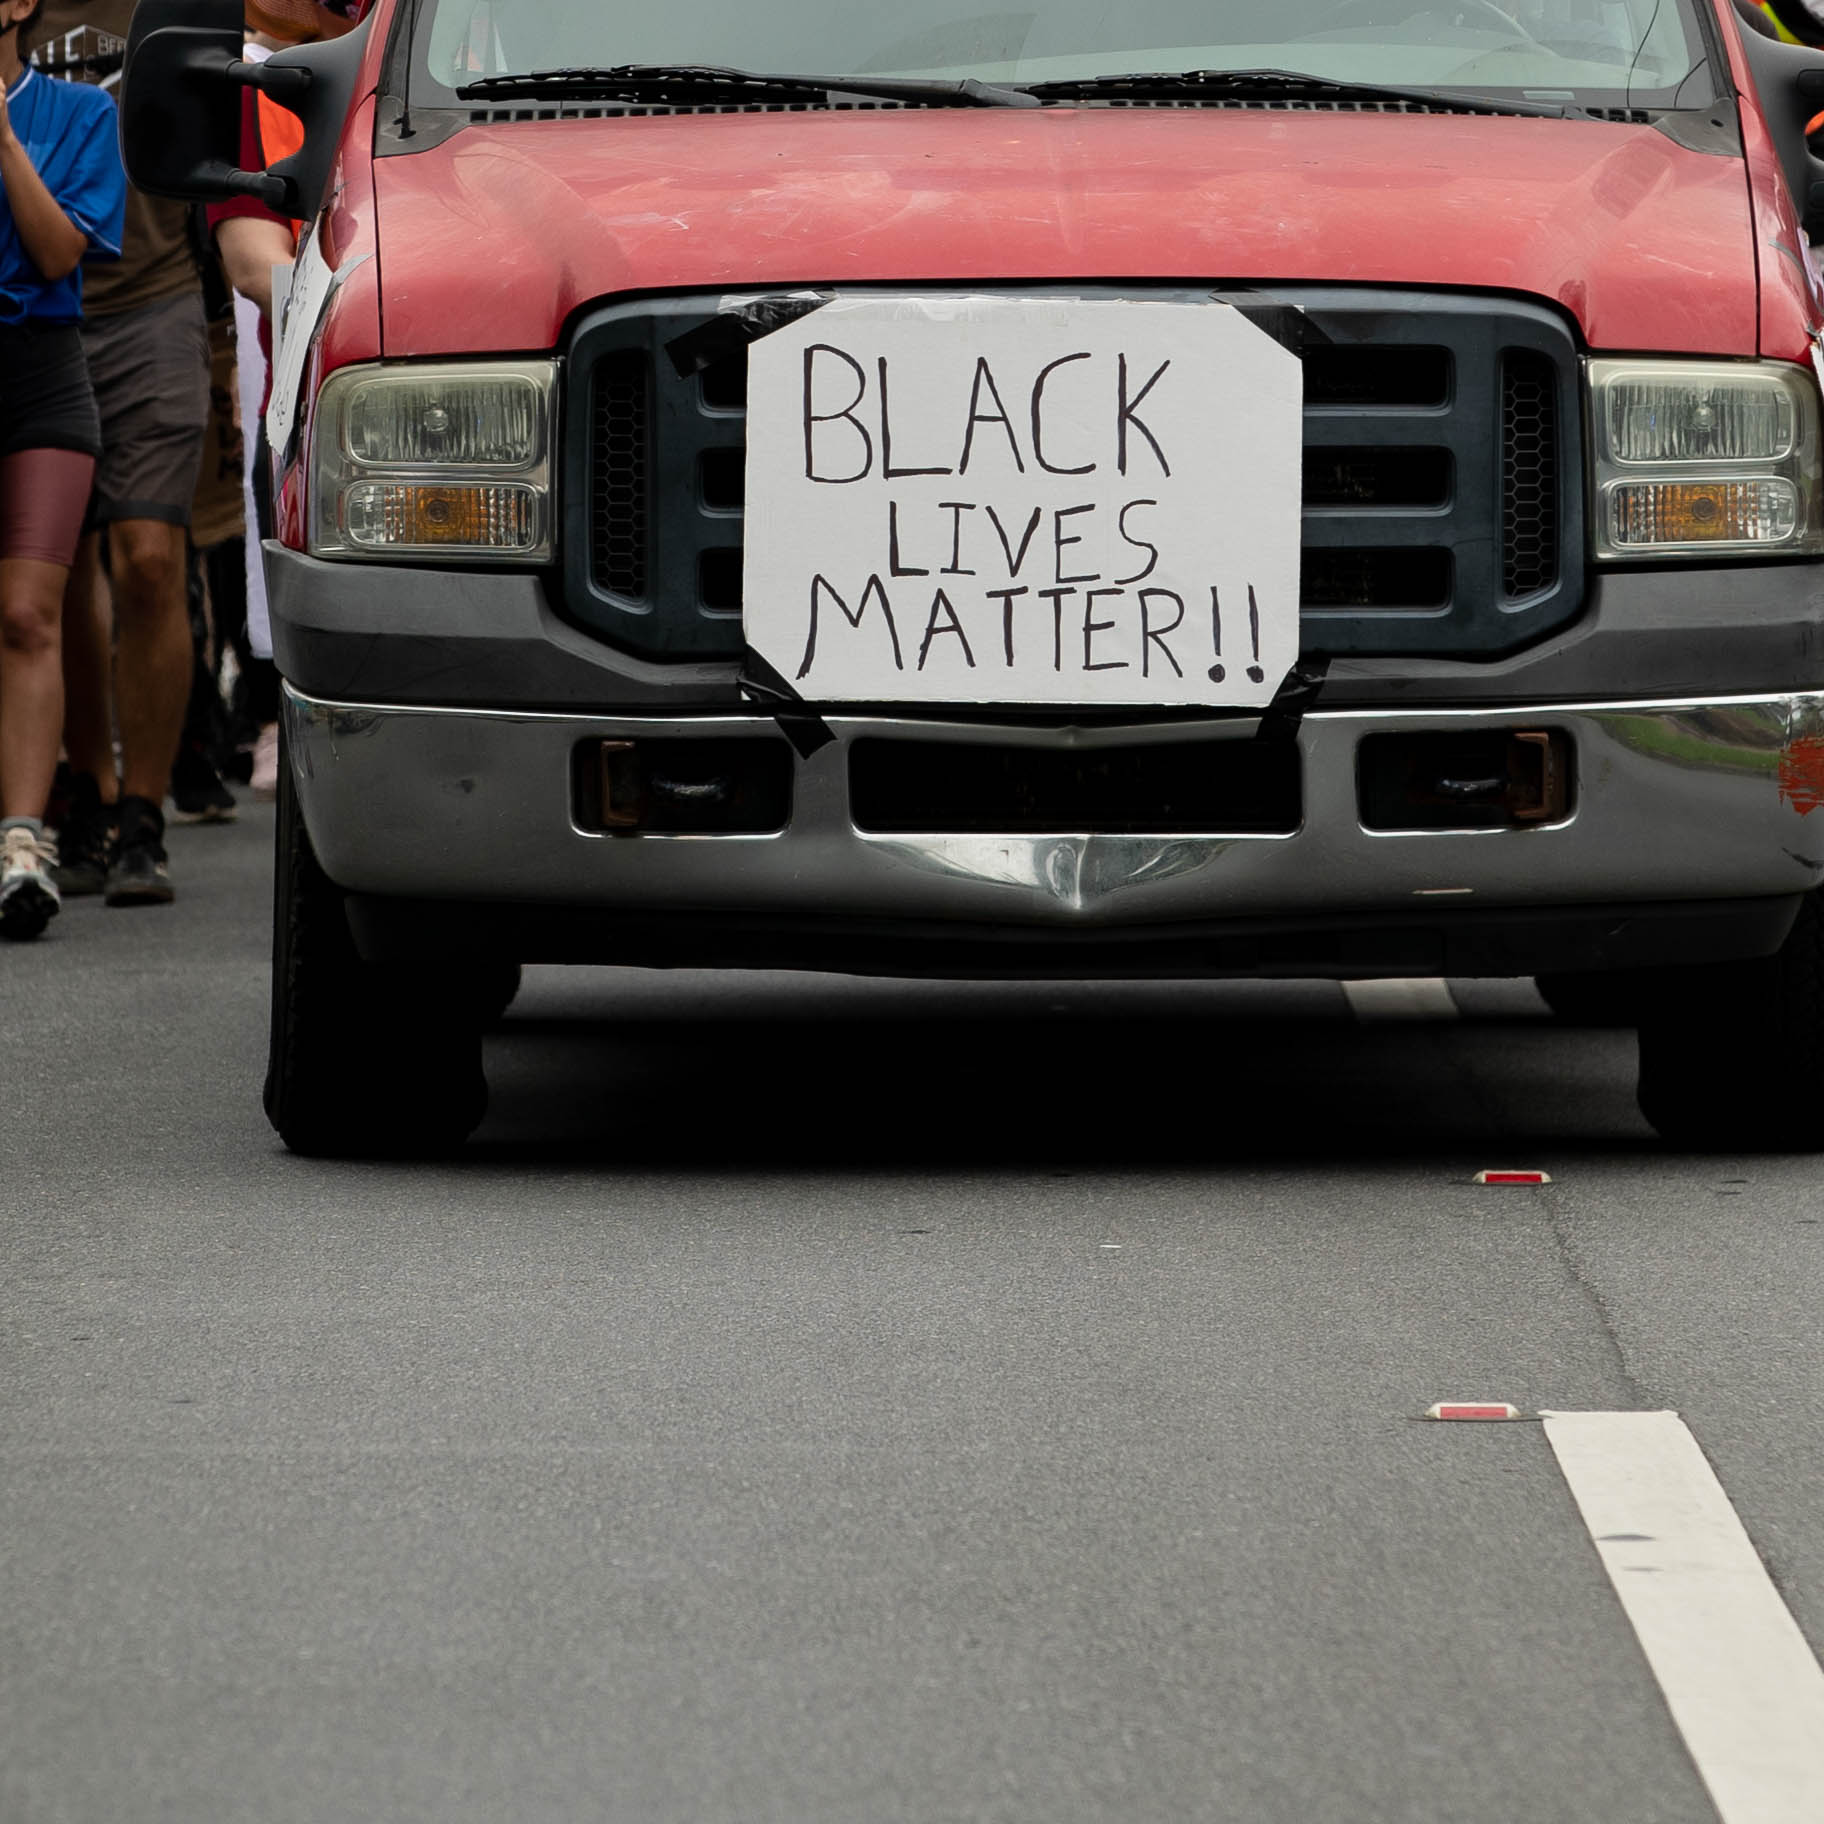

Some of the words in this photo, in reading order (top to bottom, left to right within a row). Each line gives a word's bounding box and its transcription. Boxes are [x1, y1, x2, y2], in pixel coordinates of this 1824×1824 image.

[802, 342, 1172, 484] BLACK
[888, 498, 1159, 585] LIVES
[795, 572, 1266, 684] MATTER!!
